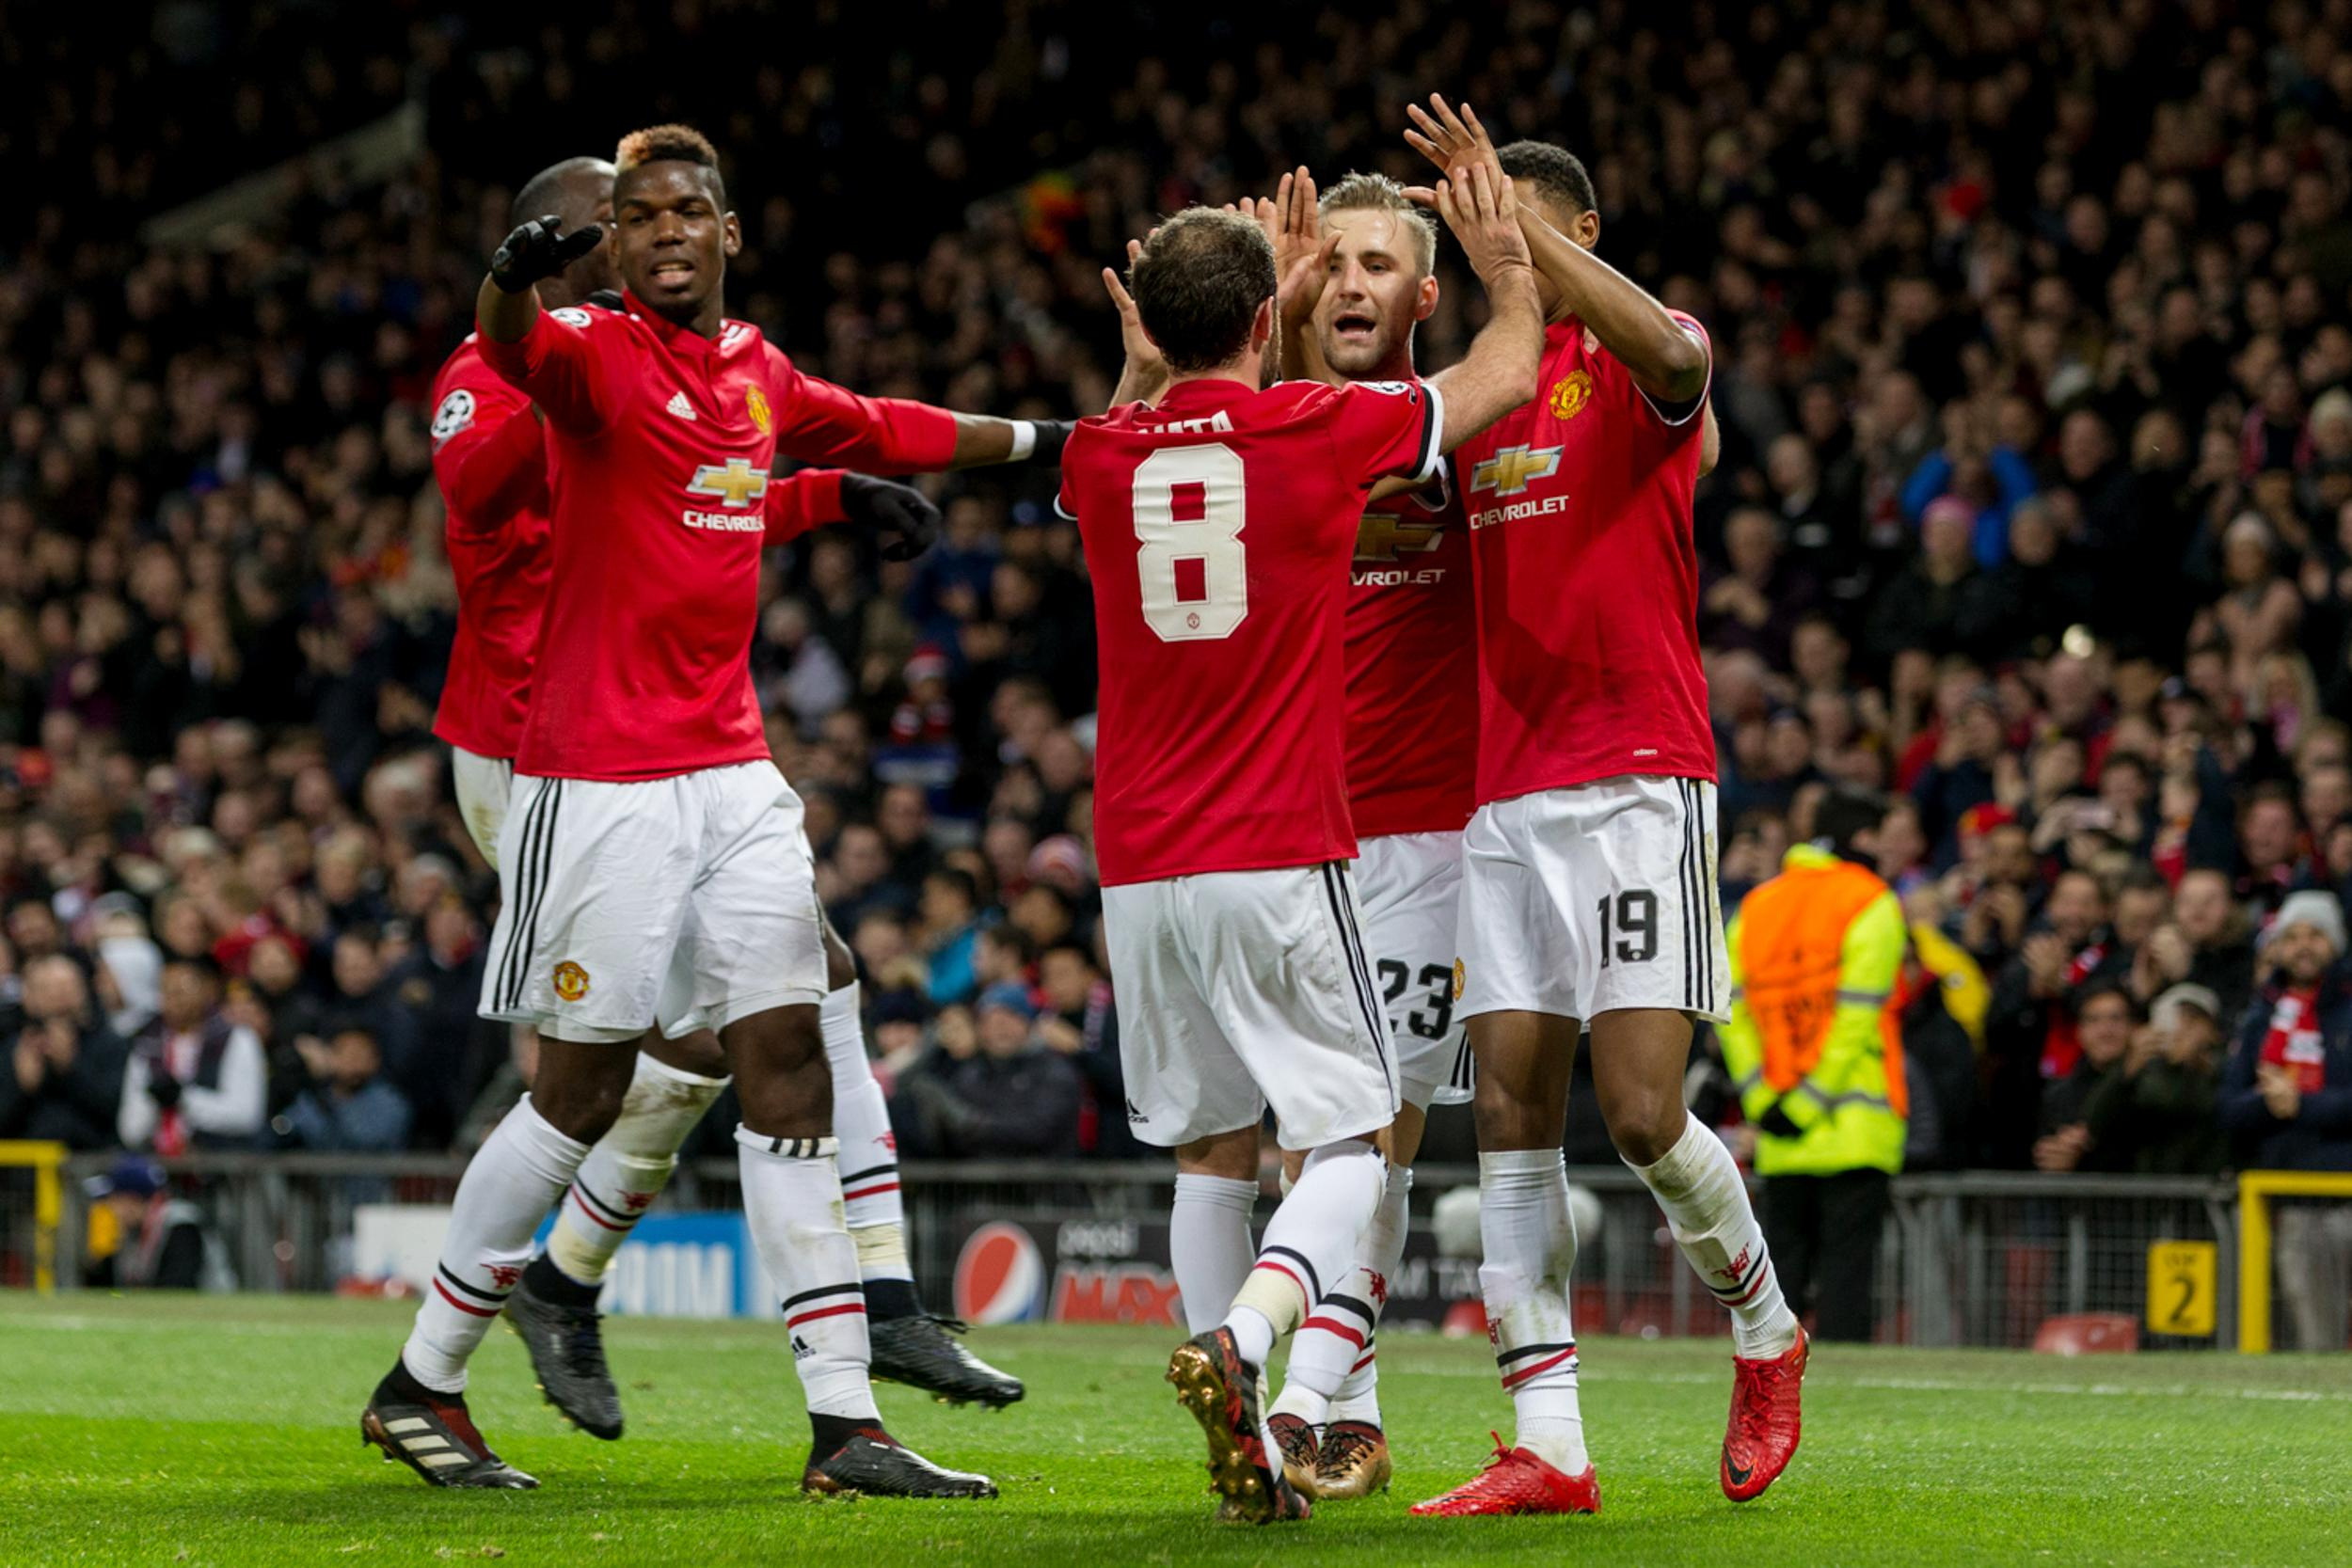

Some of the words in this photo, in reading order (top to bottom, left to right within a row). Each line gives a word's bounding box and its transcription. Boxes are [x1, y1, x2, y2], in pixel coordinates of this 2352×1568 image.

[1137, 409, 1234, 434] ATA
[683, 510, 766, 532] CHEVROL
[1470, 495, 1569, 531] CHEVROLET
[1132, 442, 1248, 642] 8
[1349, 568, 1446, 586] VROLET
[1597, 888, 1660, 970] 19
[1376, 958, 1454, 1041] 23
[1052, 1265, 1184, 1325] MAX
[2167, 1274, 2199, 1328] 2
